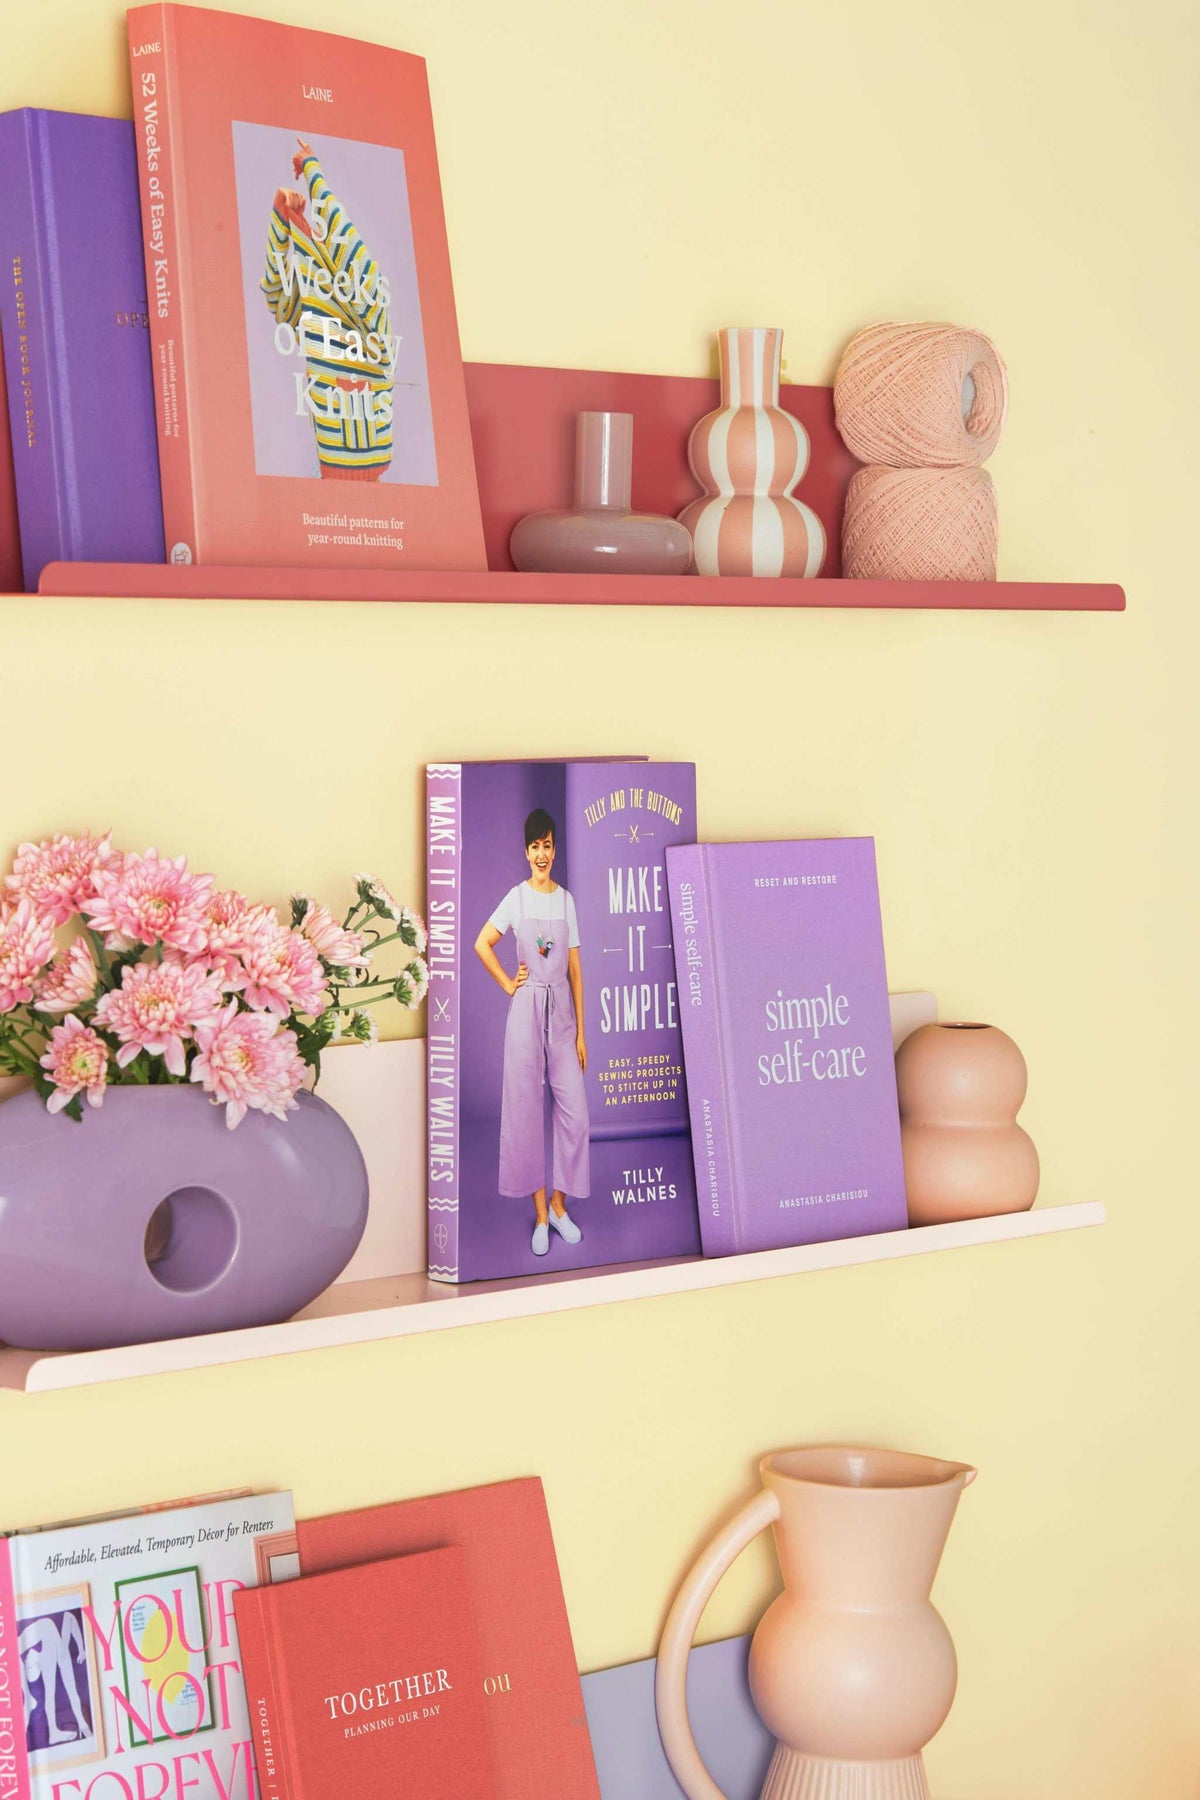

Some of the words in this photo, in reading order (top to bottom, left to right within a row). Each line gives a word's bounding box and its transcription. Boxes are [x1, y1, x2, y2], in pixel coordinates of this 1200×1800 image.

[132, 42, 161, 57] LAINE
[142, 72, 157, 97] 52
[302, 84, 334, 103] LAINE
[143, 101, 161, 172] Weeks
[149, 177, 164, 199] of
[150, 203, 165, 253] Easy
[310, 198, 348, 244] 52
[13, 256, 23, 286] THE
[155, 259, 171, 318] Knits
[272, 251, 391, 308] Weeks
[16, 291, 26, 329] OPEN
[20, 335, 31, 375] BOOK
[167, 339, 177, 382] Beautiful
[274, 310, 313, 358] of
[321, 316, 403, 379] Easy
[159, 343, 170, 396] year-round
[21, 380, 36, 448] JOURNAL
[164, 397, 172, 436] knitting
[169, 383, 178, 422] patterns
[293, 372, 394, 422] Knits
[302, 513, 348, 527] Beautiful
[349, 517, 389, 531] patterns
[390, 517, 405, 530] for
[307, 533, 362, 546] year-round
[364, 533, 404, 551] knitting
[429, 796, 456, 856] MAKE
[584, 796, 607, 828] TILLY
[610, 789, 626, 813] AND
[629, 787, 644, 809] THE
[646, 790, 683, 826] BUTTONS
[429, 868, 456, 888] IT
[608, 865, 664, 915] MAKE
[754, 877, 780, 888] RESET
[782, 877, 799, 886] AND
[801, 875, 837, 886] RESTORE
[680, 883, 699, 934] simple
[429, 900, 456, 981] SIMPLE
[628, 925, 646, 972] IT
[686, 939, 703, 1007] self-care
[600, 982, 677, 1034] SIMPLE
[765, 983, 850, 1039] simple
[430, 1034, 455, 1088] TILLY
[598, 1070, 633, 1082] SEWING
[636, 1066, 682, 1078] PROJECTS
[609, 1058, 634, 1068] EASY,
[637, 1054, 671, 1066] SPEEDY
[758, 1039, 867, 1086] self-care
[603, 1084, 614, 1094] TO
[618, 1081, 649, 1093] STITCH
[652, 1080, 664, 1089] UP
[667, 1079, 678, 1088] IN
[605, 1097, 618, 1106] AN
[621, 1091, 676, 1105] AFTERNOON
[430, 1096, 455, 1183] WALNES
[703, 1098, 714, 1157] ANASTASIA
[612, 1184, 677, 1206] WALNES
[622, 1166, 664, 1186] TILLY
[708, 1160, 720, 1217] CHARISIOU
[779, 1195, 823, 1209] ANASTASIA
[825, 1189, 869, 1203] CHARISIOU
[44, 1550, 97, 1574] Affordable,
[100, 1539, 143, 1560] Elevated,
[146, 1534, 195, 1553] Temporary
[198, 1527, 225, 1543] Décor
[225, 1522, 240, 1542] for
[242, 1520, 274, 1535] Renters
[109, 1660, 241, 1754] NOT
[324, 1668, 453, 1720] TOGETHER
[258, 1697, 276, 1776] TOGETHER
[343, 1717, 395, 1739] PLANNING
[398, 1710, 420, 1725] OUR
[423, 1704, 441, 1718] DAY
